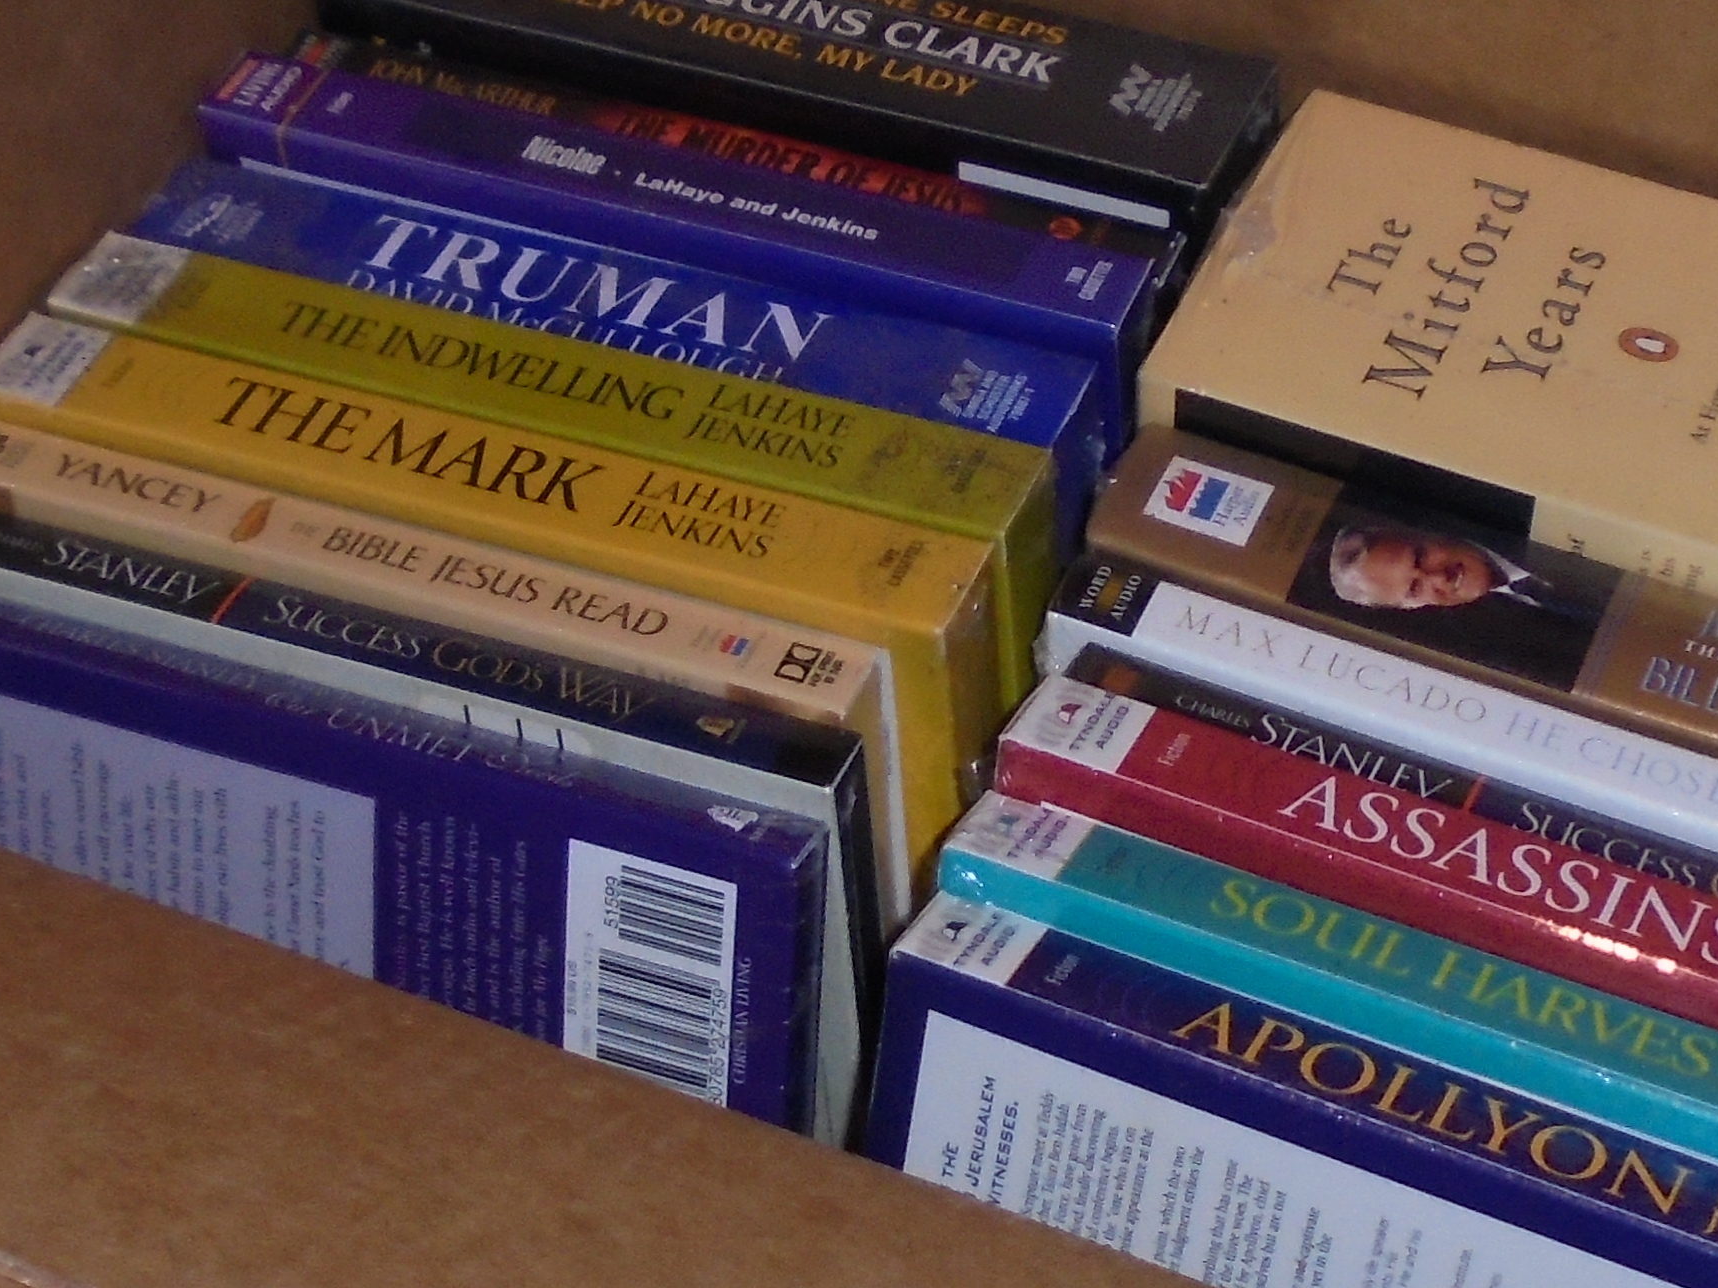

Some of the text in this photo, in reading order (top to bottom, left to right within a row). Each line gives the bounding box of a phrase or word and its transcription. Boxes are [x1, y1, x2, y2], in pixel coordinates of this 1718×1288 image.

[690, 11, 803, 60] MORE,
[816, 42, 877, 73] MY
[881, 57, 980, 97] LADY
[883, 19, 1063, 84] CLARK
[929, 0, 1069, 46] SLEEPS
[521, 135, 608, 175] Nicolae
[634, 171, 879, 243] LaHaye and Jenkins
[357, 213, 834, 364] TRUMAN
[1326, 216, 1413, 296] The
[1361, 176, 1532, 402] Mitford
[1480, 244, 1608, 382] Years
[279, 301, 686, 424] THE INDWELLING
[682, 414, 843, 472] JENKINS
[702, 383, 857, 439] LAHAYE
[212, 375, 606, 515] THE MARK
[613, 500, 775, 561] JENKINS
[630, 470, 785, 530] LAHAYE
[54, 453, 222, 514] YANCEY
[321, 526, 430, 575] BIBLE
[430, 553, 543, 605] JESUS
[549, 585, 670, 637] READ
[1078, 564, 1113, 611] WORD
[1109, 573, 1142, 622] AUDIO
[41, 537, 223, 605] STANLEY
[261, 594, 433, 659] SUCCESS
[554, 668, 657, 722] WAY
[1175, 605, 1282, 658] MAX
[1297, 642, 1487, 724] LUCADO
[1504, 708, 1556, 750] HE
[1096, 704, 1130, 751] AUDIO
[213, 785, 227, 856] lives with
[285, 797, 300, 854] teaches
[1249, 712, 1454, 800] STANLEY
[1511, 801, 1698, 889] SUCCESS
[310, 827, 325, 863] God
[440, 812, 455, 870] known
[394, 860, 411, 911] pastor
[416, 818, 435, 935] Baptist Church
[603, 872, 620, 930] 51599
[485, 874, 501, 1009] and author
[952, 912, 1004, 967] TYNDALE
[980, 924, 1018, 967] AUDIO
[1209, 879, 1409, 978] SOUL
[733, 954, 756, 1006] LIVING
[706, 985, 732, 1050] 274759
[964, 1074, 996, 1188] JERUSALEM
[1037, 1089, 1055, 1124] Teddy
[1168, 1002, 1695, 1216] APOLLYON
[941, 1141, 958, 1180] THE
[1060, 1101, 1086, 1190] have from
[1089, 1161, 1110, 1227] conference
[1158, 1188, 1177, 1228] which
[1181, 1165, 1199, 1204] strikes
